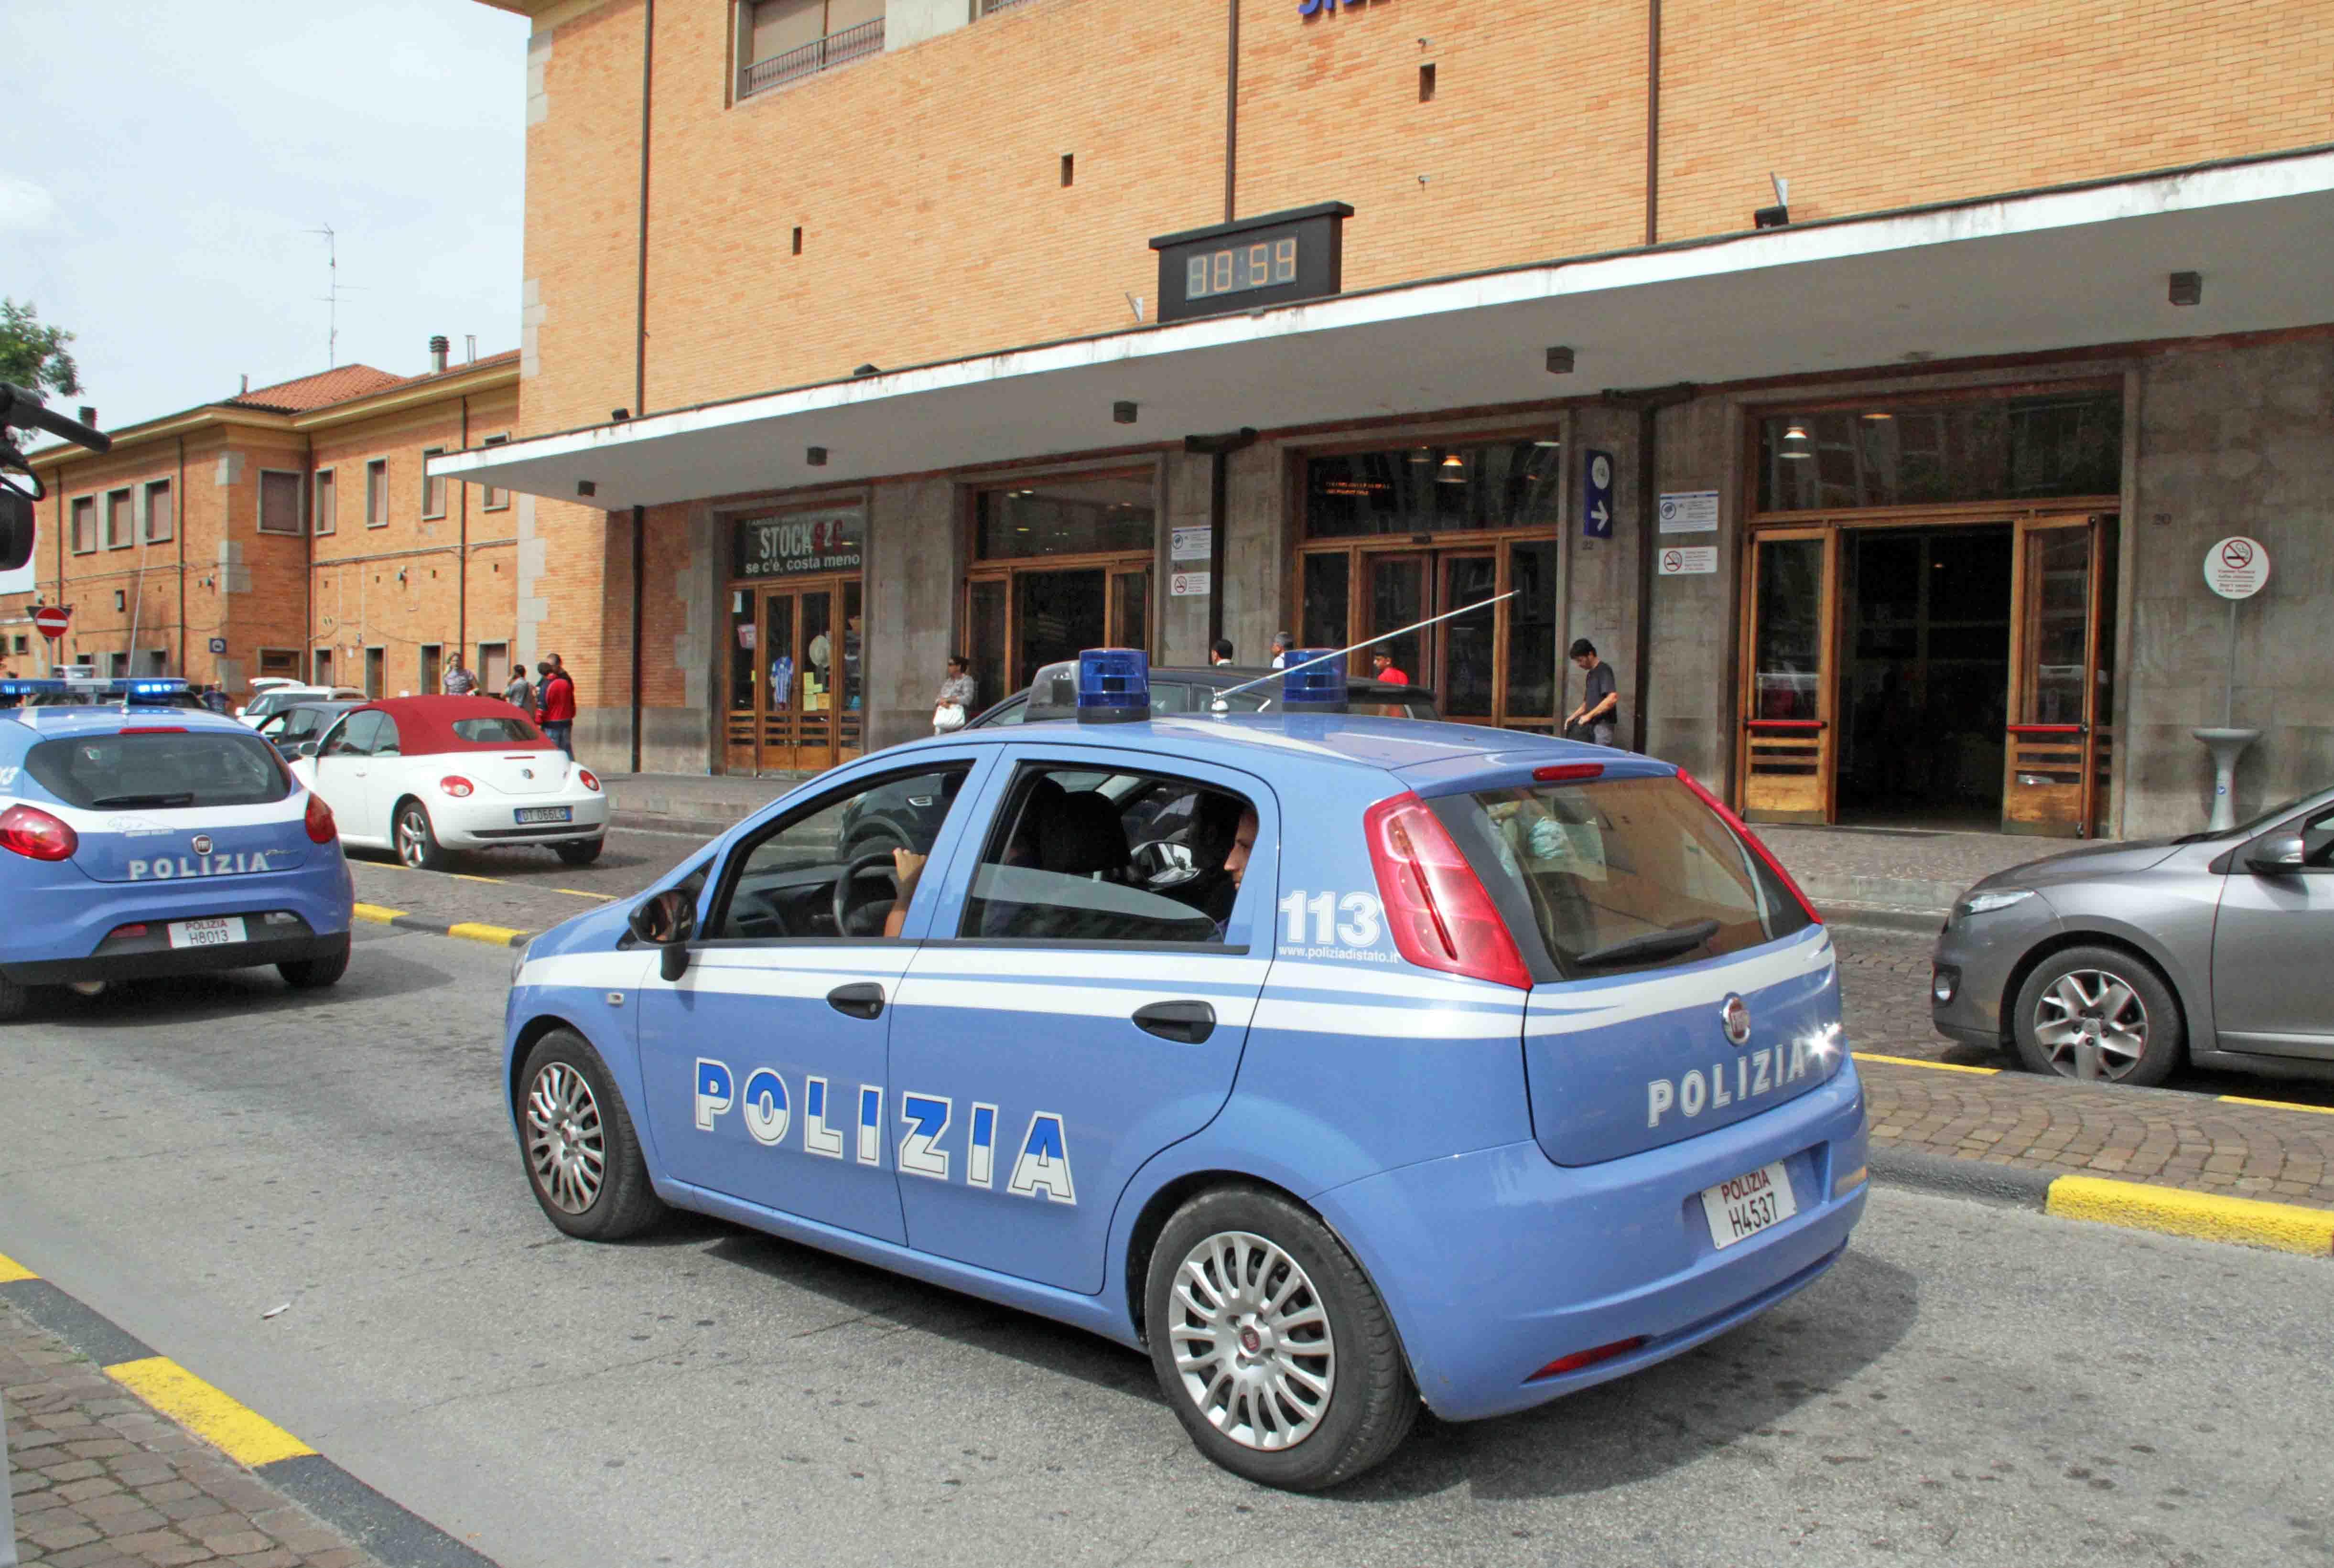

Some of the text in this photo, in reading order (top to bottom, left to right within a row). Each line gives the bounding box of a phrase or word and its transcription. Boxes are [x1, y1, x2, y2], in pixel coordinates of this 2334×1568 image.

[760, 523, 813, 558] STOCK
[746, 563, 759, 574] se
[787, 558, 820, 570] costa
[824, 554, 859, 567] meno
[129, 852, 270, 880] POLIZIA
[185, 919, 228, 931] POLIZIA
[1279, 890, 1381, 947] 113
[190, 929, 228, 945] H8013
[1278, 946, 1399, 964] www.poliziadistato.it
[1647, 1038, 1806, 1128] POLIZIA
[695, 1057, 1077, 1205] POLIZIA
[1721, 1169, 1771, 1204] POLIZIA
[1729, 1191, 1777, 1237] H4537
